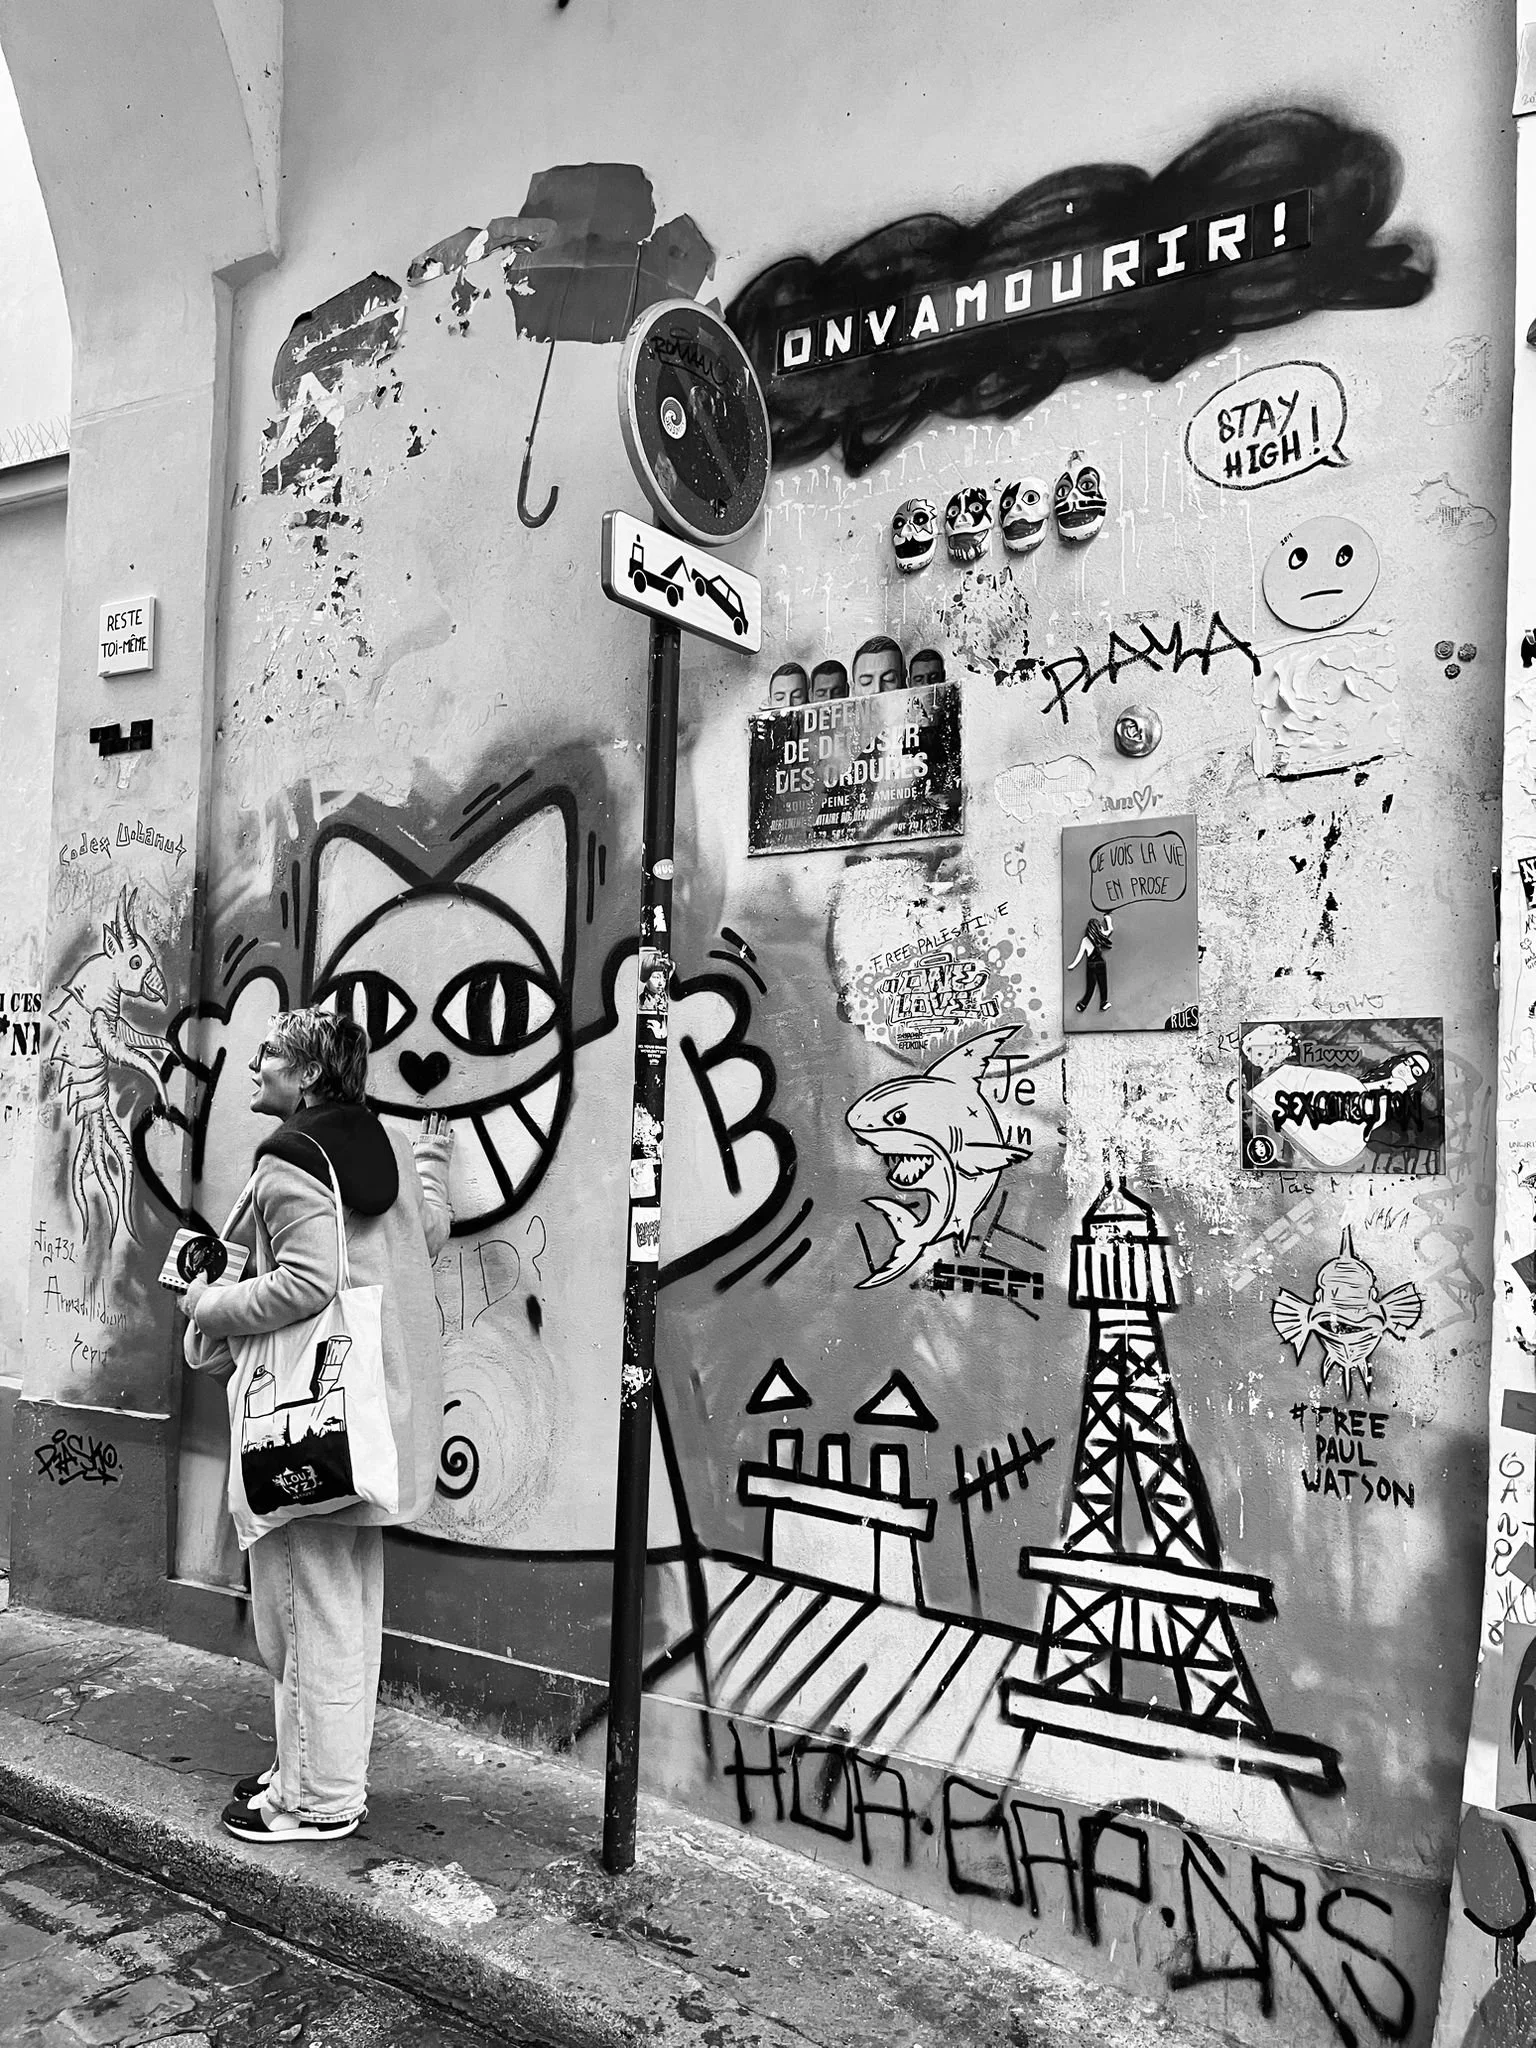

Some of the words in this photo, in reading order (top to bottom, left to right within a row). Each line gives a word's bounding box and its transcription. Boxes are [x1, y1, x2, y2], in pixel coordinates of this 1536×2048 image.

[1216, 390, 1300, 443] STAY
[107, 608, 143, 632] RESTE
[784, 738, 809, 765] DE
[775, 766, 815, 795] DES
[823, 752, 929, 788] ORDURES
[821, 793, 850, 809] PEINE
[58, 832, 112, 867] Codex
[1140, 842, 1157, 865] LA
[1105, 879, 1124, 901] EN
[1131, 876, 1170, 898] PROSE
[869, 943, 912, 975] FREE
[917, 901, 1010, 955] PALESTINE
[1170, 1006, 1199, 1029] RUES
[1315, 1433, 1378, 1468] PAUL
[1301, 1467, 1415, 1509] WATSON
